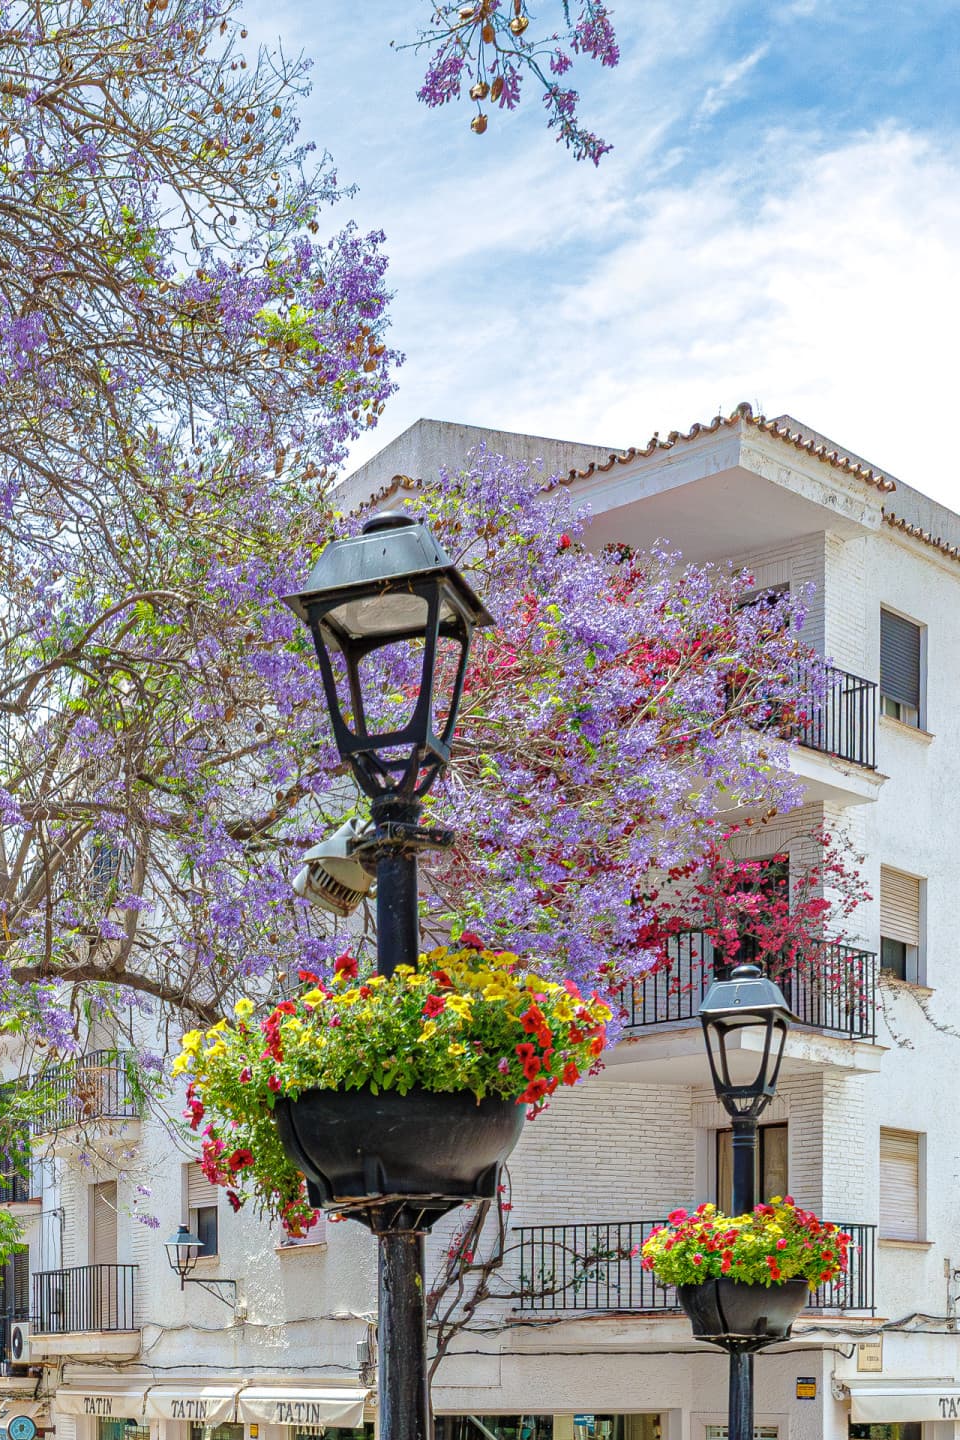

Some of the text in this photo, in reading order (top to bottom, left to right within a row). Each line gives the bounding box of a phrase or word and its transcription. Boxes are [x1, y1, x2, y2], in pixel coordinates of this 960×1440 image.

[84, 1397, 113, 1414] TATIN
[171, 1400, 207, 1418] TATIN
[276, 1402, 321, 1423] TATIN
